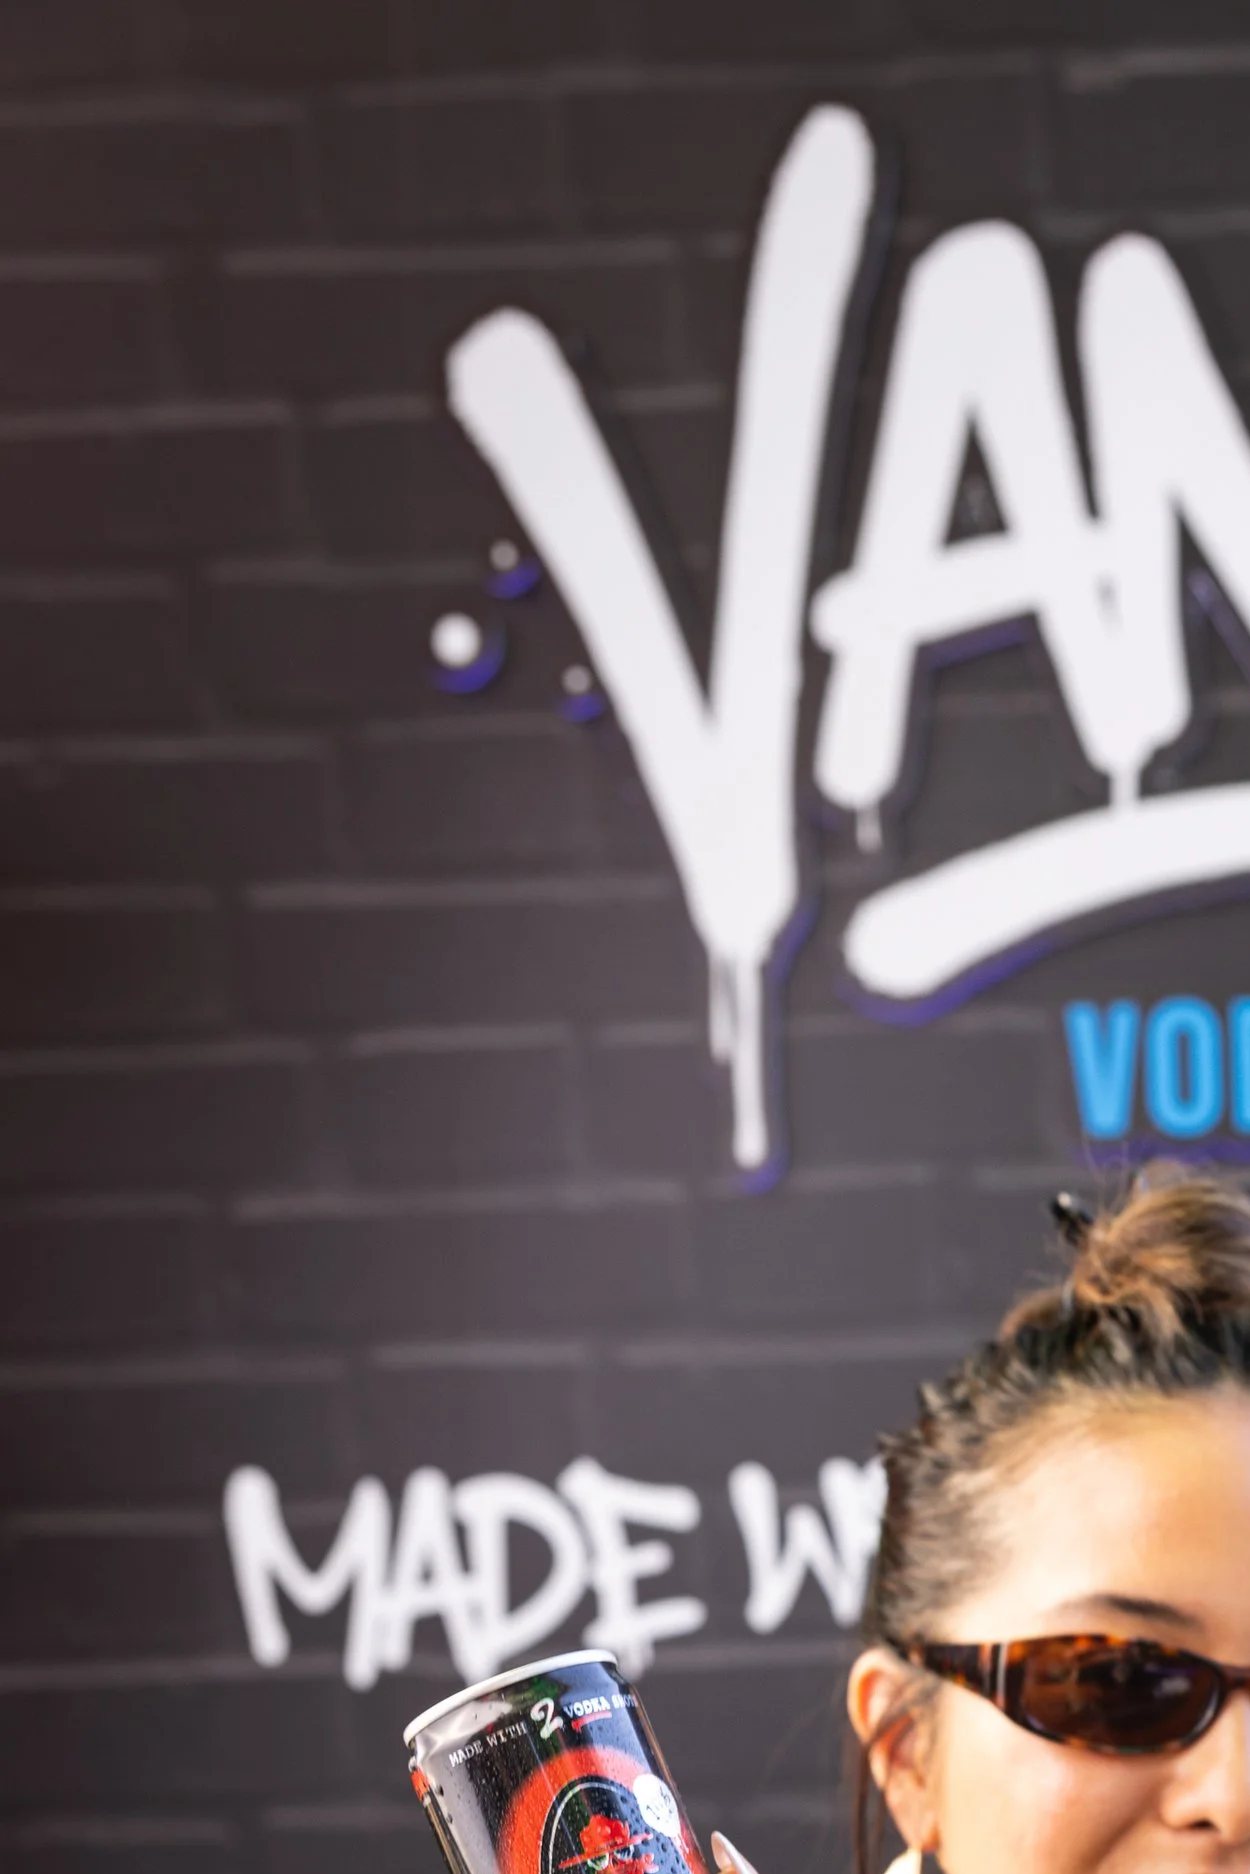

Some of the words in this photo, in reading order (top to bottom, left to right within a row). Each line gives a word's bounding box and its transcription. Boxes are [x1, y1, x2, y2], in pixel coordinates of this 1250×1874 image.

[224, 1455, 707, 1692] MADE
[449, 1740, 484, 1768] MADE
[488, 1721, 528, 1748] WITH
[530, 1697, 565, 1740] 2
[563, 1696, 611, 1718] VODKA
